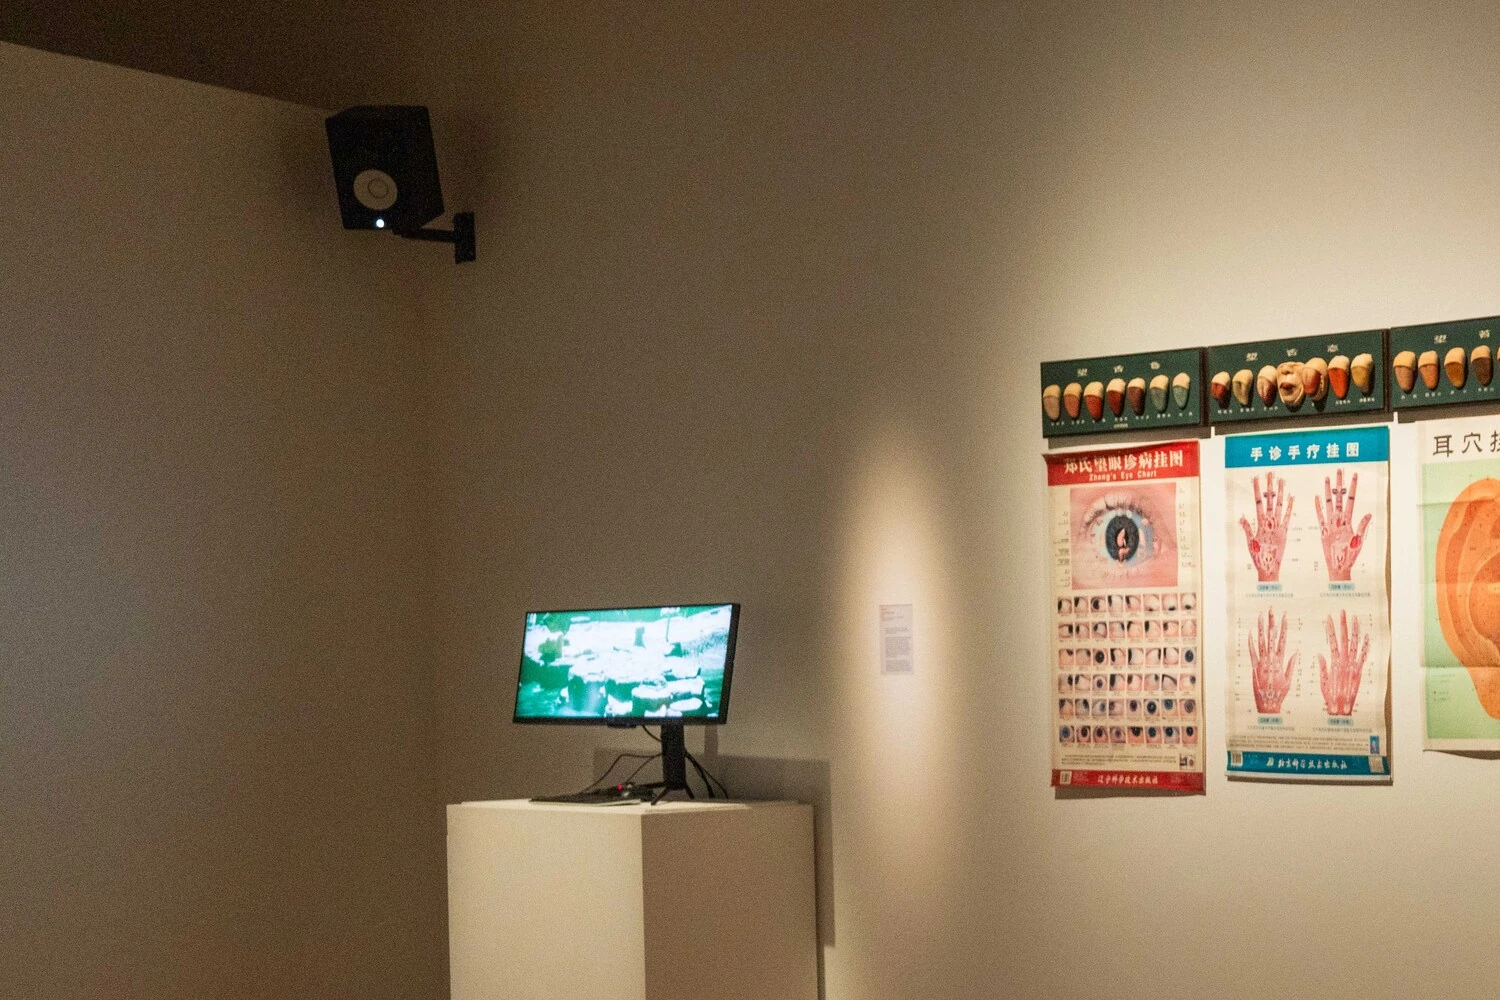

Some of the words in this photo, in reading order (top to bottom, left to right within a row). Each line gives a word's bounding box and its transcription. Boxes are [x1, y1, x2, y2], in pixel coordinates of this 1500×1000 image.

[1064, 450, 1184, 474] 郑氏望眼诊病挂图
[1250, 442, 1360, 462] 手诊手疗挂图
[1121, 471, 1133, 481] Eye
[1137, 469, 1157, 479] Chart
